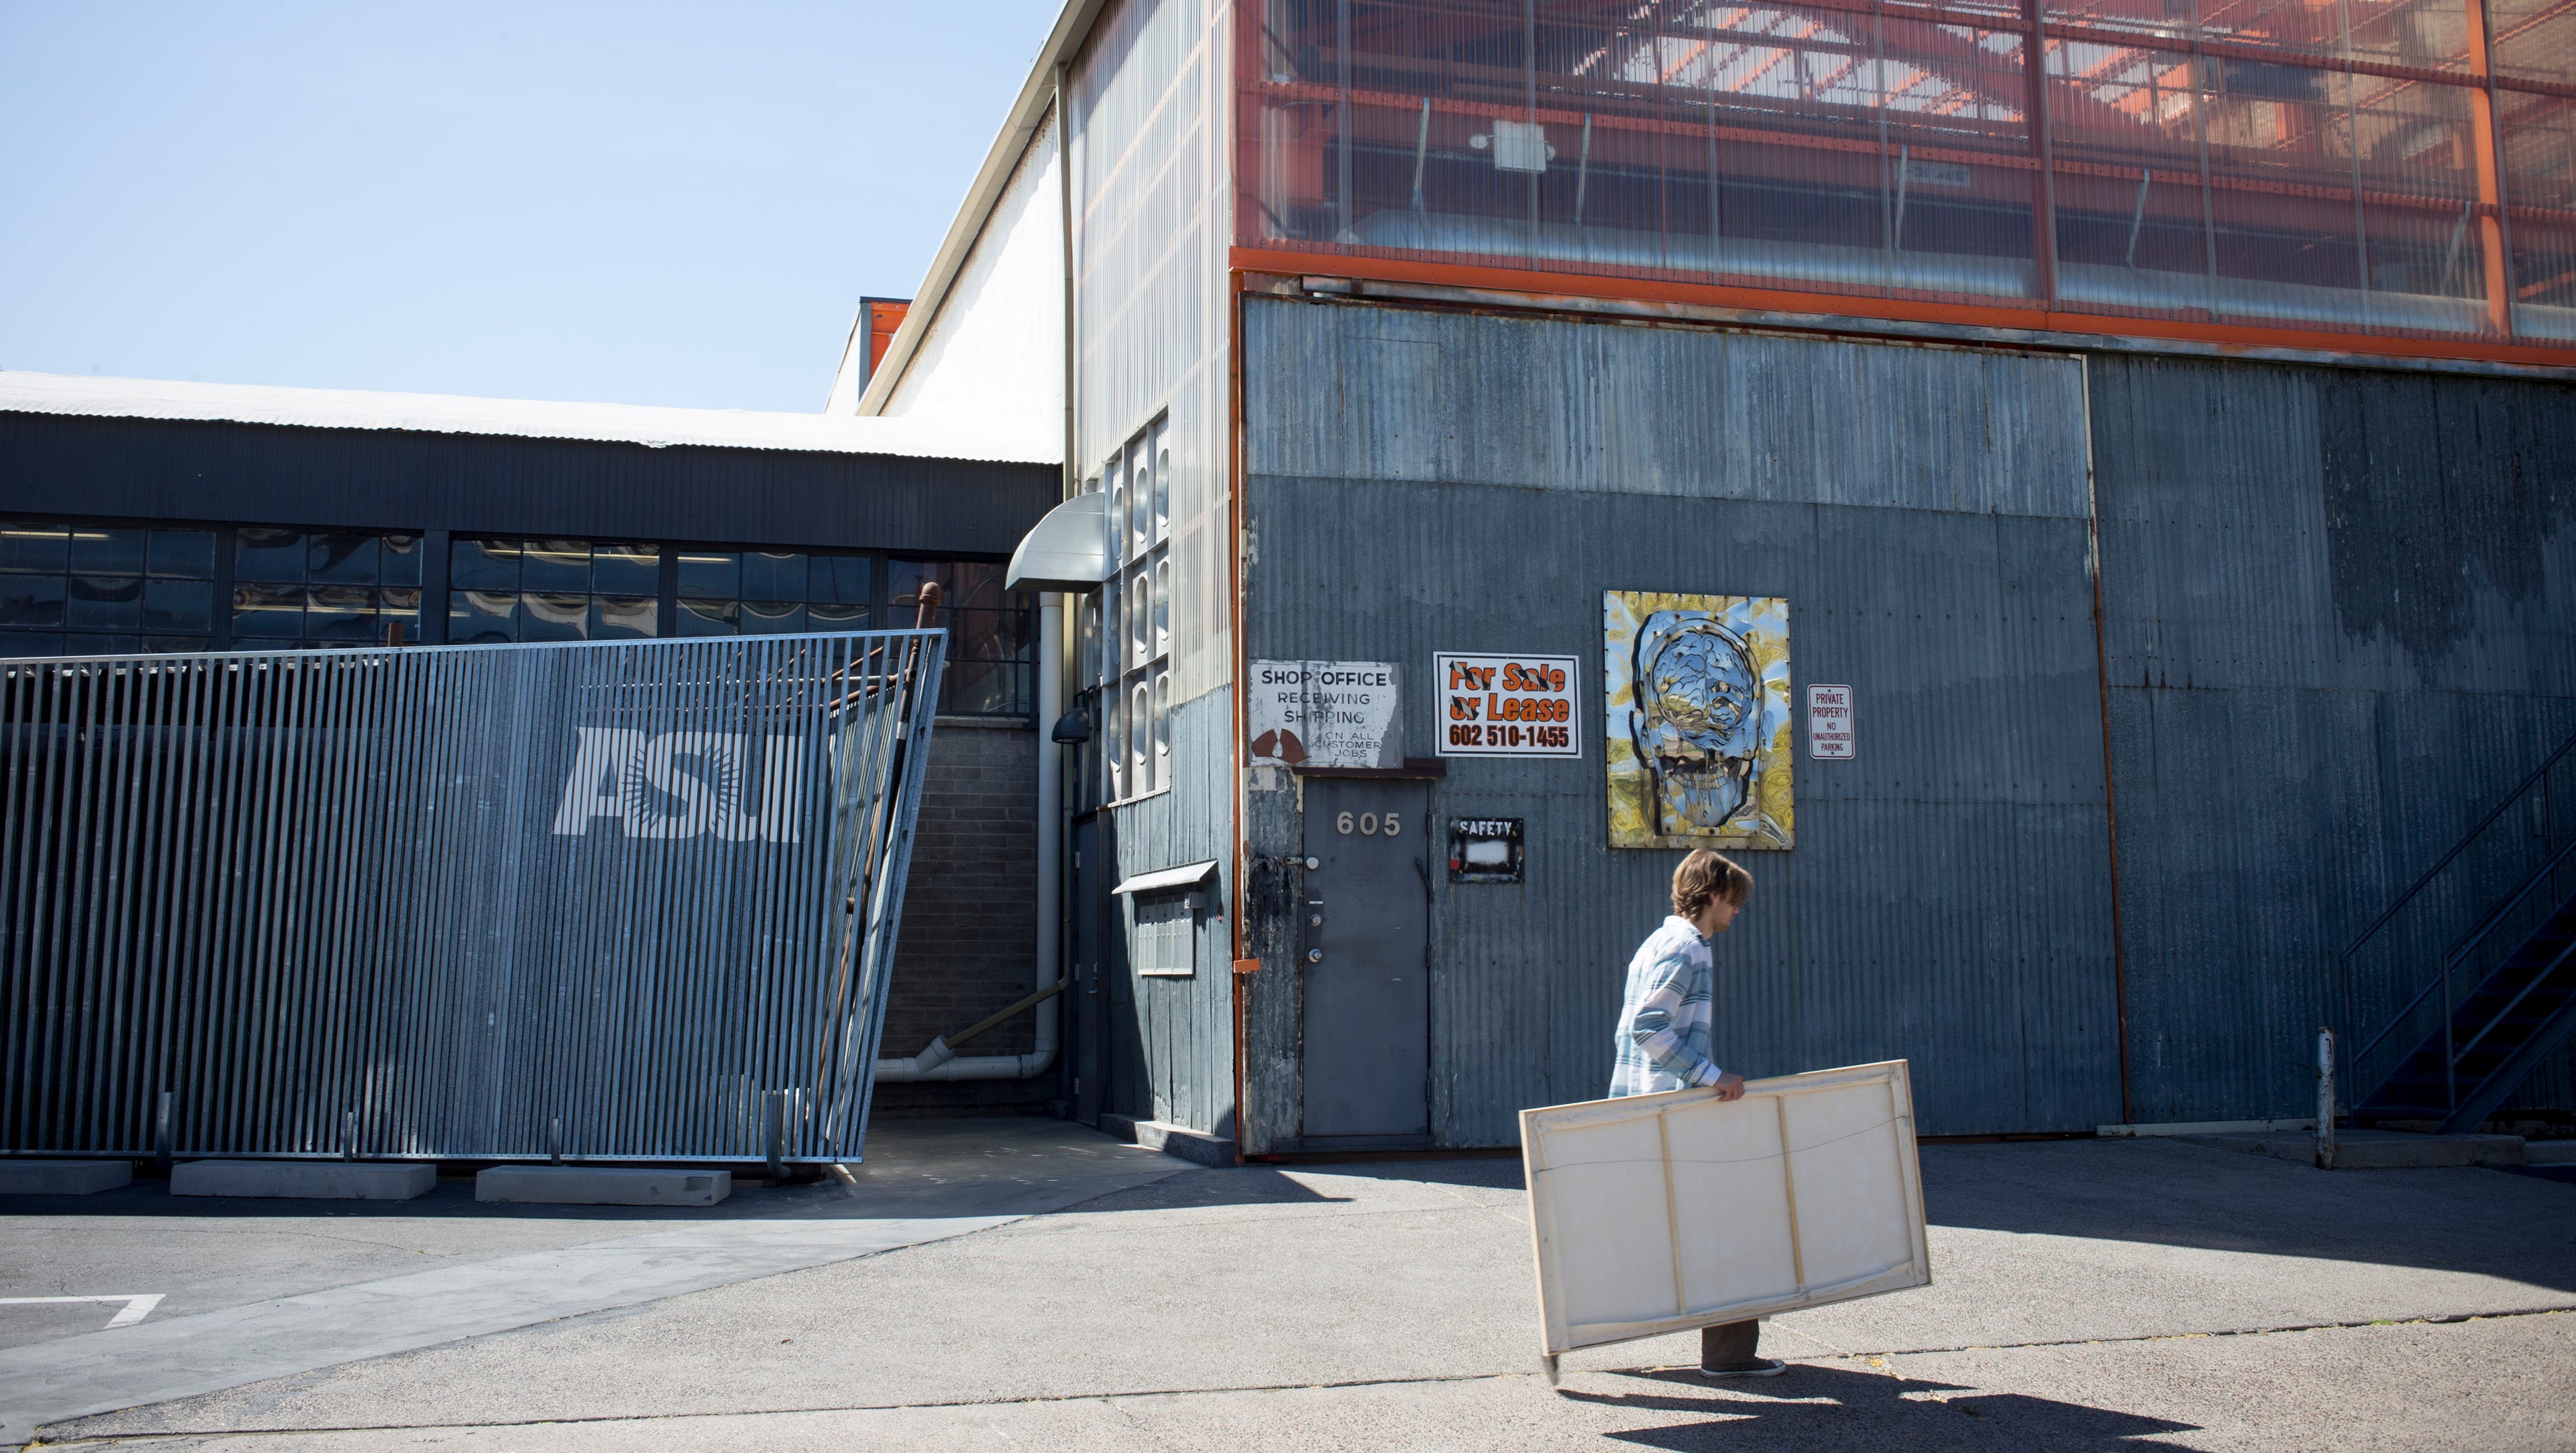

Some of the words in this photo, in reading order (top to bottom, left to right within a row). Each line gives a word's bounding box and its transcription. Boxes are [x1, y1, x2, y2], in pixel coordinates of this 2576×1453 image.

[1262, 670, 1312, 685] SHOP
[1321, 671, 1387, 686] OFFICE
[1449, 662, 1496, 690] For
[1502, 662, 1566, 692] Sale
[1277, 692, 1370, 705] RECEIVING
[1815, 693, 1844, 704] PRIVATE
[1450, 696, 1481, 720] or
[1487, 693, 1569, 723] Lease
[1812, 707, 1848, 718] PROPERTY
[1284, 710, 1365, 723] SHIPPING
[1351, 732, 1374, 740] ALL
[1449, 724, 1483, 746] 602
[1486, 725, 1569, 748] 510-1455
[1314, 740, 1381, 749] CUSTOMER
[1335, 749, 1367, 758] JOBS
[551, 726, 804, 843] ASU
[1337, 811, 1401, 836] 605
[1460, 821, 1512, 836] SAFETY
